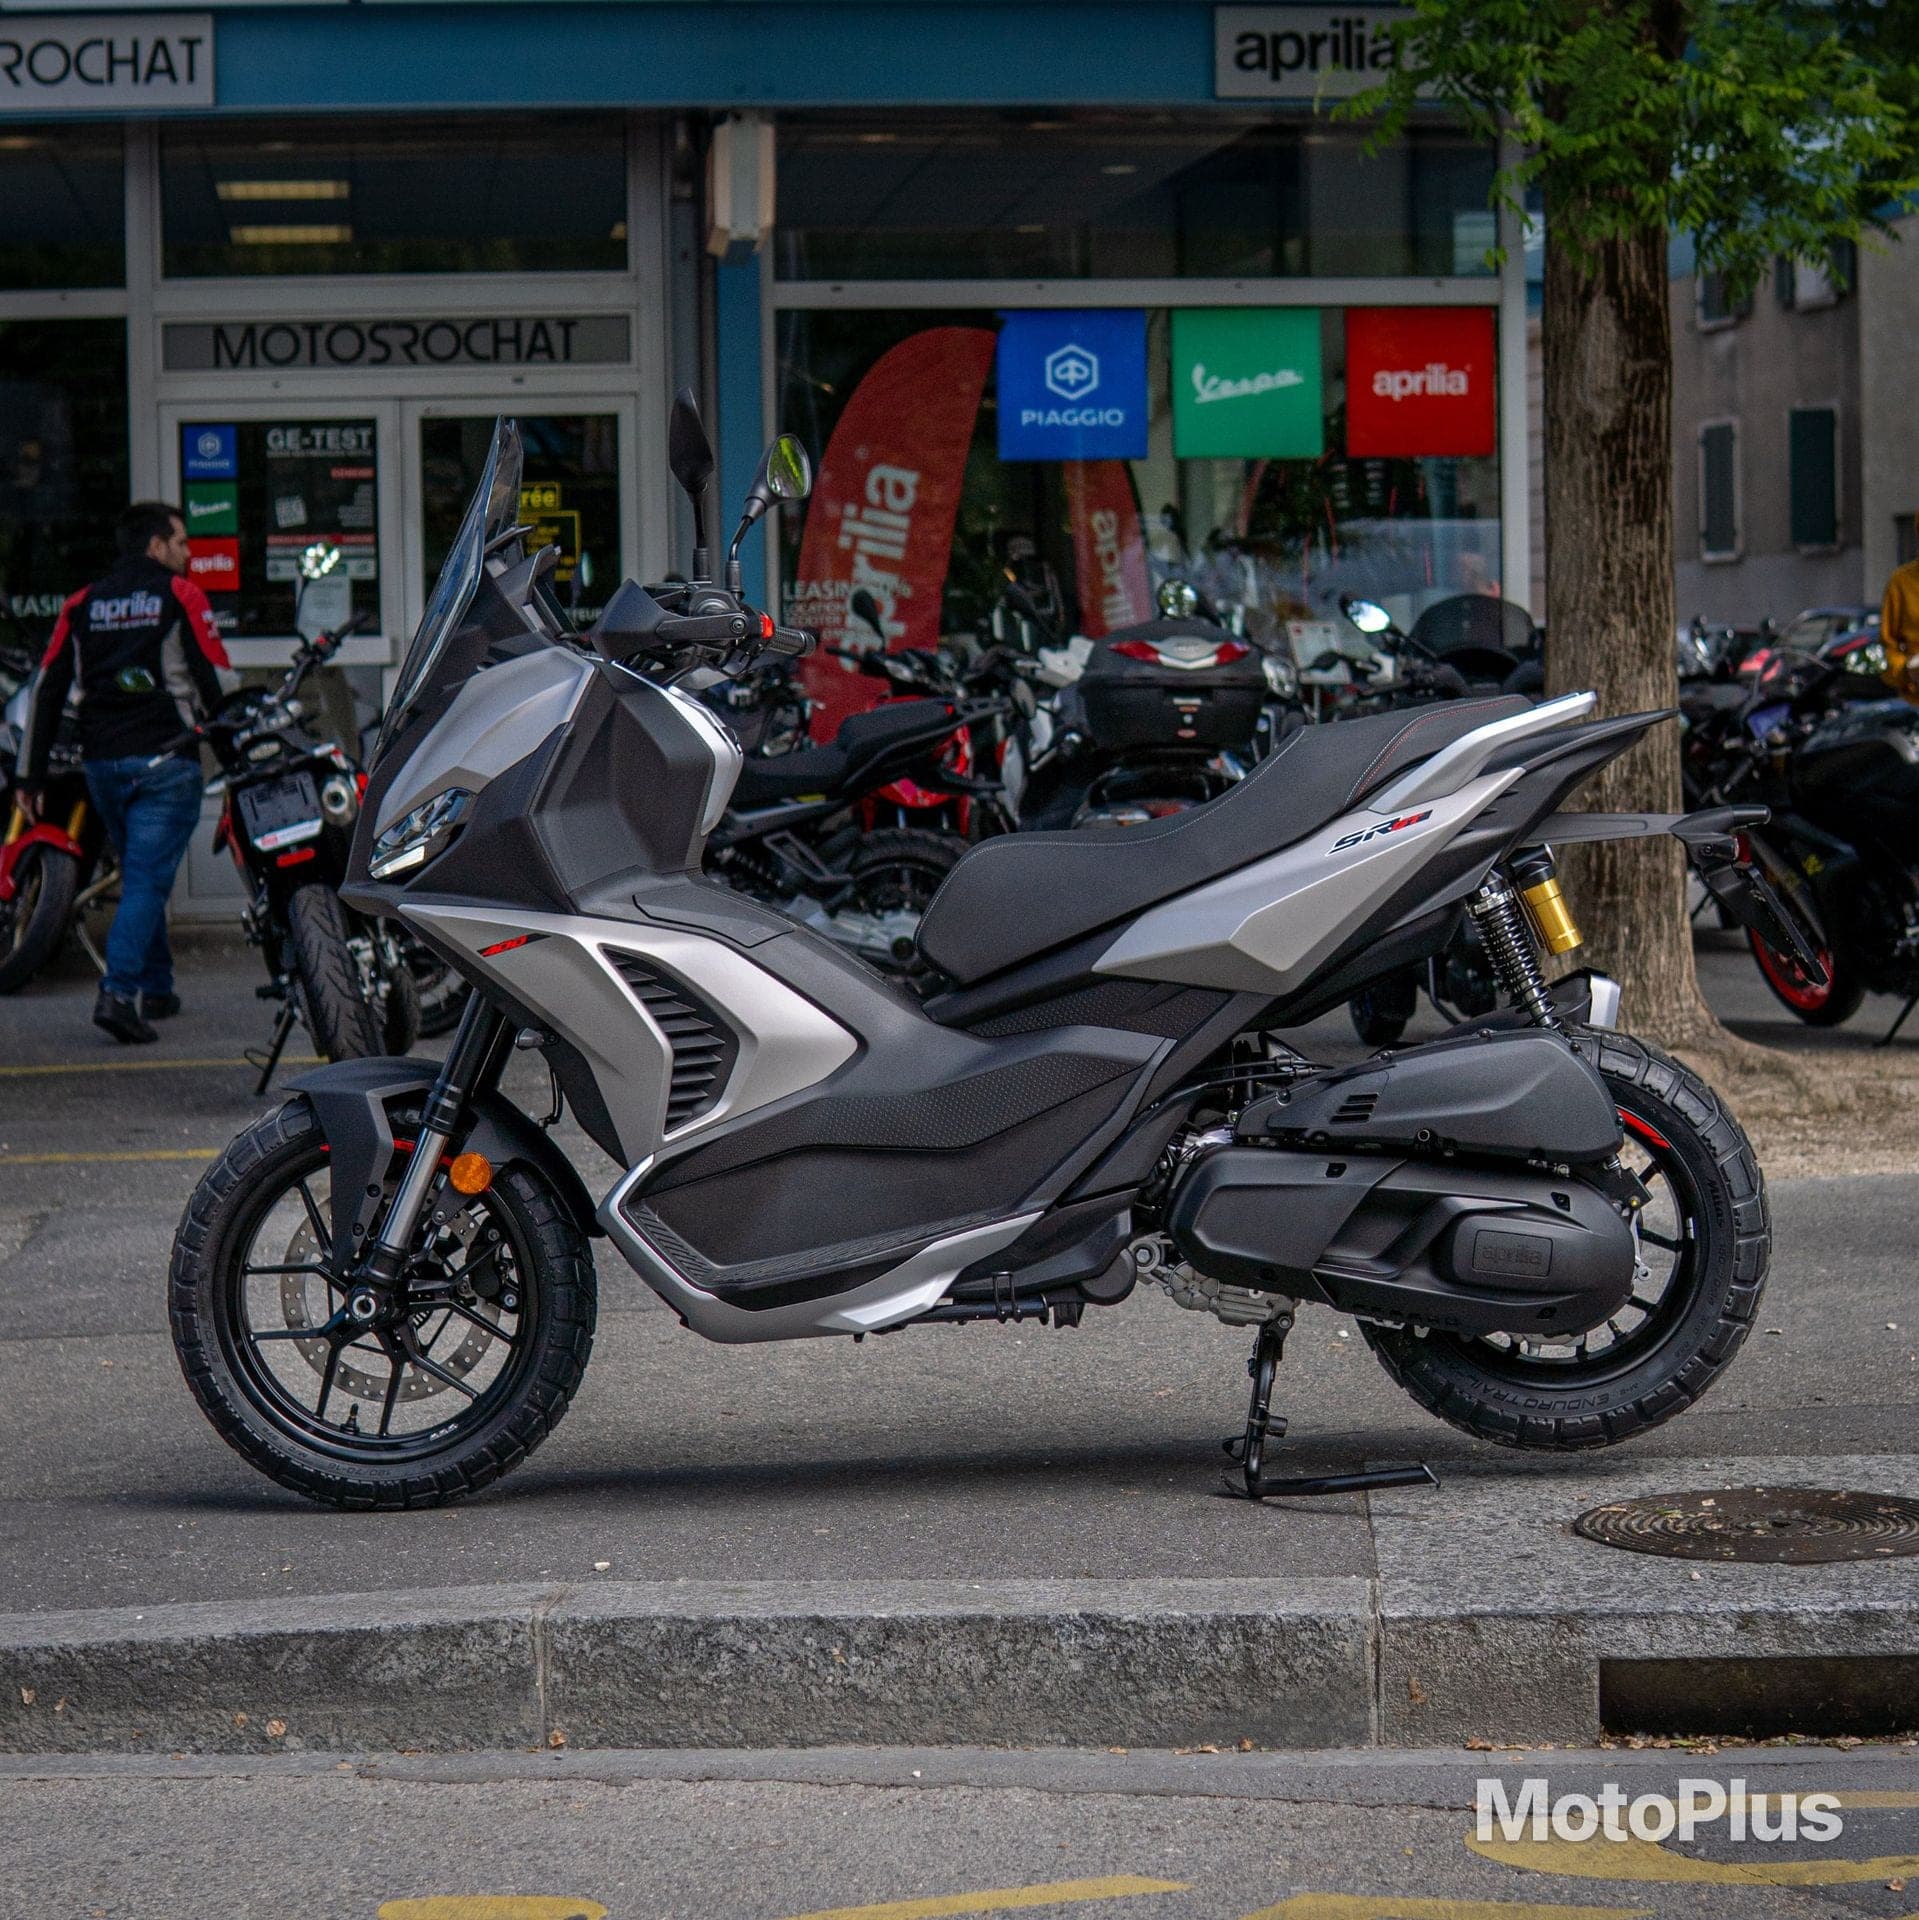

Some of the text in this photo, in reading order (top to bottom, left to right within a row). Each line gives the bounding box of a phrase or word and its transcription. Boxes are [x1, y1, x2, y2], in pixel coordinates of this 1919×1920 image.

[0, 37, 202, 87] ROCHAT
[1235, 17, 1396, 82] aprilia
[212, 320, 578, 369] MOTOSROCHAT
[1193, 363, 1303, 403] Vespa
[1373, 363, 1468, 400] aprilia
[1021, 408, 1126, 427] PIAGGIO
[190, 554, 235, 573] aprilia
[90, 590, 163, 621] aprilia
[1522, 1392, 1611, 1411] ENDURO
